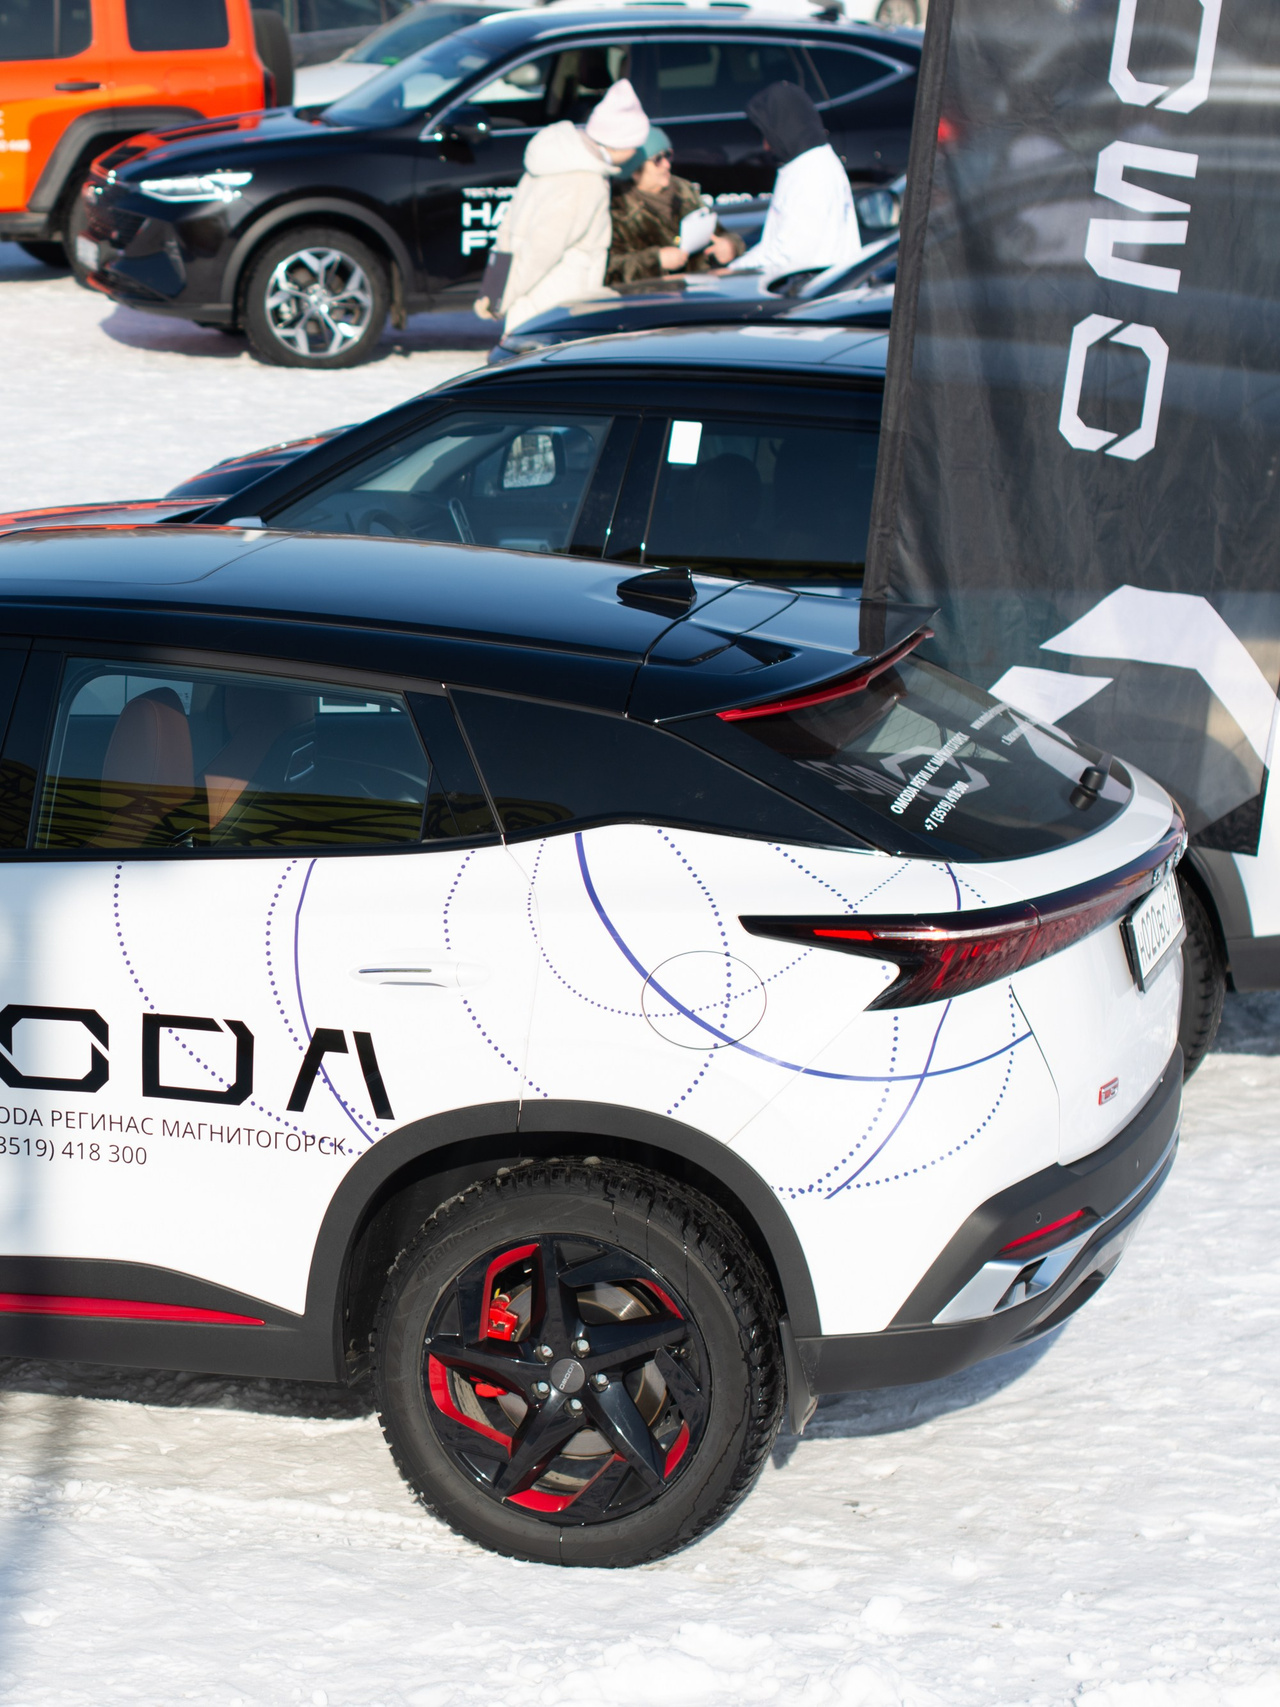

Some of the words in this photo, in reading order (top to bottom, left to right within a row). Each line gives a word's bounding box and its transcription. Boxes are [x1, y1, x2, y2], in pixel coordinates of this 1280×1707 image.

[50, 1109, 154, 1136] РЕГИНАС
[162, 1119, 347, 1157] МАГНИТОГОРСК
[61, 1141, 101, 1162] 418
[108, 1145, 148, 1166] 300
[559, 1362, 576, 1390] OMODA
